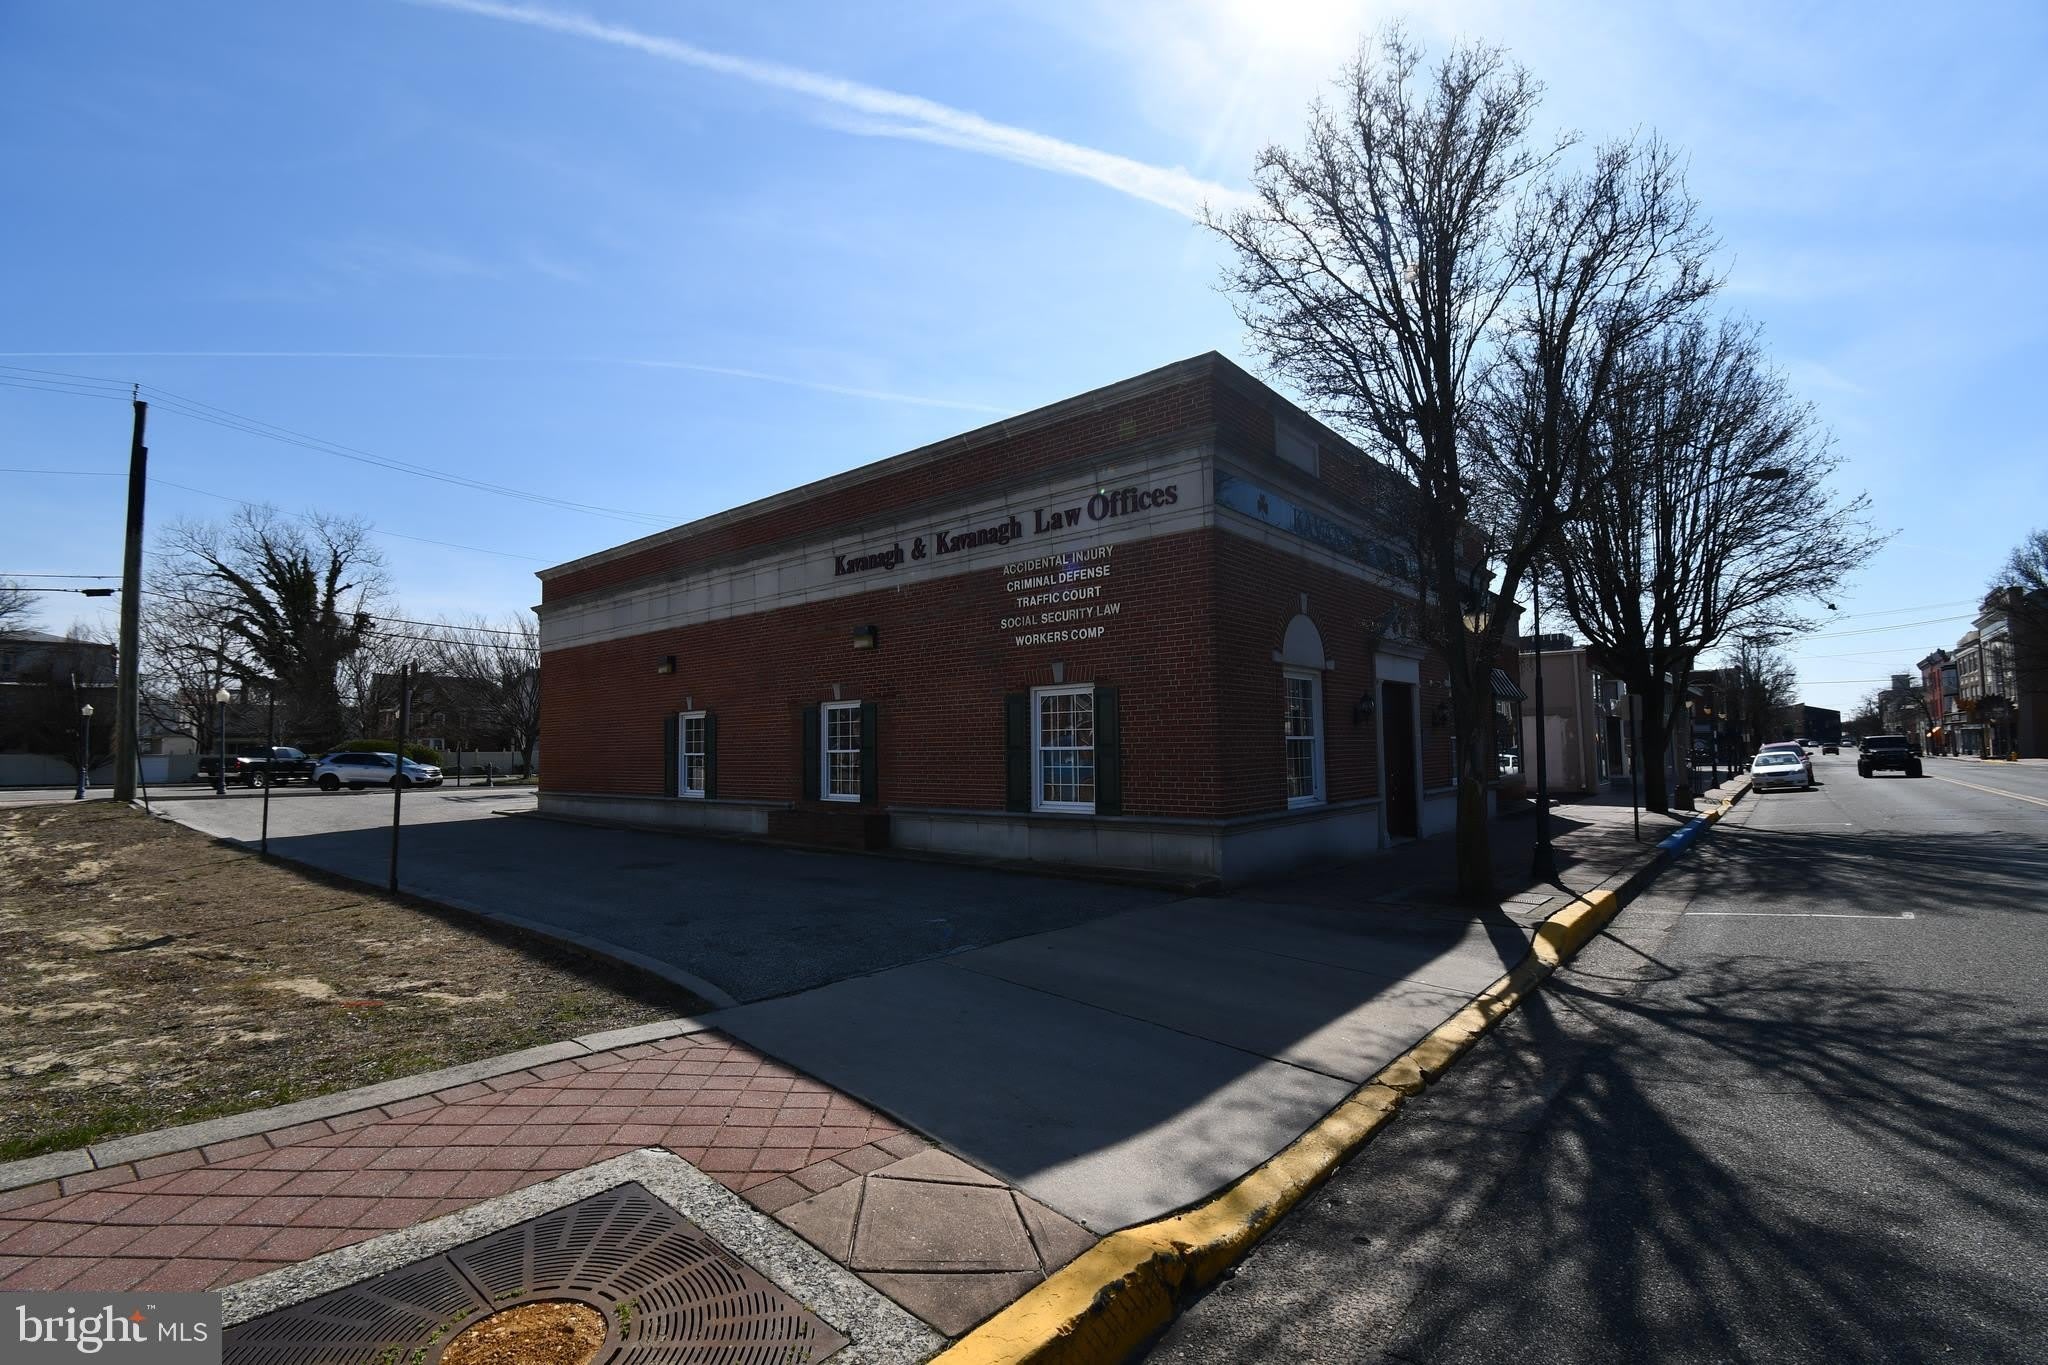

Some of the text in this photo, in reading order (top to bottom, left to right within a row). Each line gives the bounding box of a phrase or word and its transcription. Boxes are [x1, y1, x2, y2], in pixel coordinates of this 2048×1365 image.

[834, 485, 1179, 576] Kavanagh & Kavanagh Law Offices
[1003, 545, 1114, 576] ACCIDENTAL INJURY
[1006, 564, 1111, 593] CRIMINAL DEFENSE
[1016, 585, 1102, 609] TRAFFIC COURT
[1000, 602, 1121, 629] SOCIAL SECURITY LAW
[1015, 626, 1105, 647] WORKERS COMP
